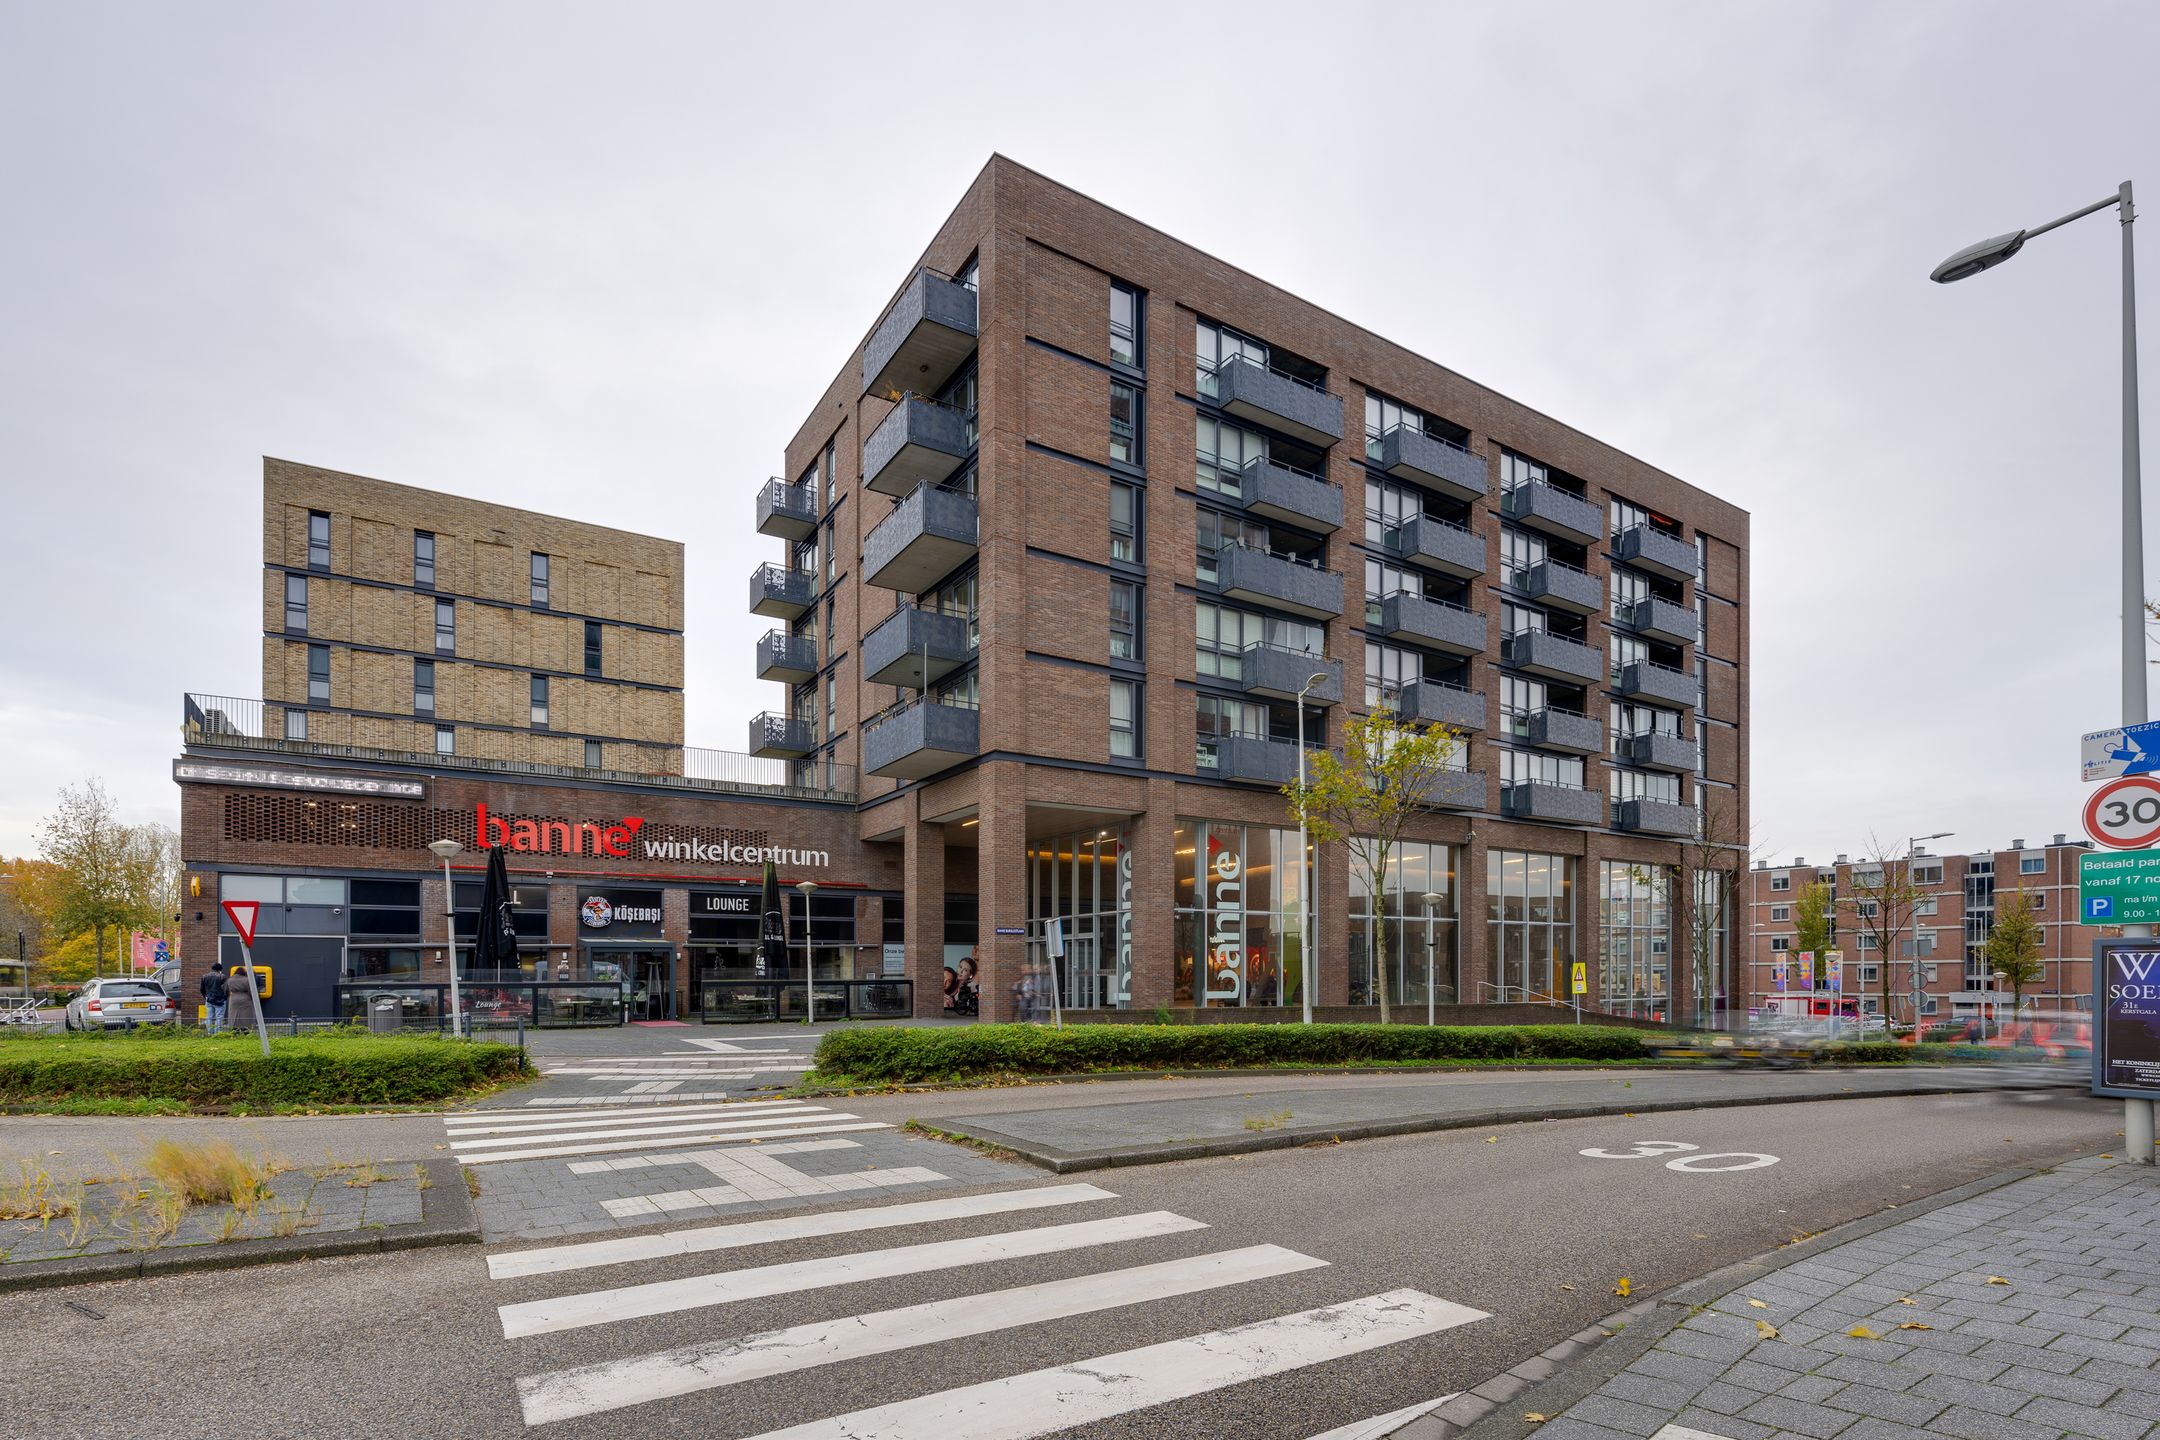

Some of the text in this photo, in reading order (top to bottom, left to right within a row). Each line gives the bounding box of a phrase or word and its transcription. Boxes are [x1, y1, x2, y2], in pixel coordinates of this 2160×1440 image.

[2084, 730, 2122, 742] CAMERA
[2102, 797, 2160, 828] 30
[476, 803, 829, 867] banne winkelcentrum
[2084, 859, 2134, 871] Betaald
[2085, 876, 2122, 887] vanaf
[2125, 875, 2141, 885] 17
[707, 897, 750, 911] LOUNGE
[2142, 895, 2158, 903] t/m
[2123, 909, 2145, 918] 9.00
[1207, 851, 1241, 1000] banne
[2109, 984, 2160, 1000] SOE
